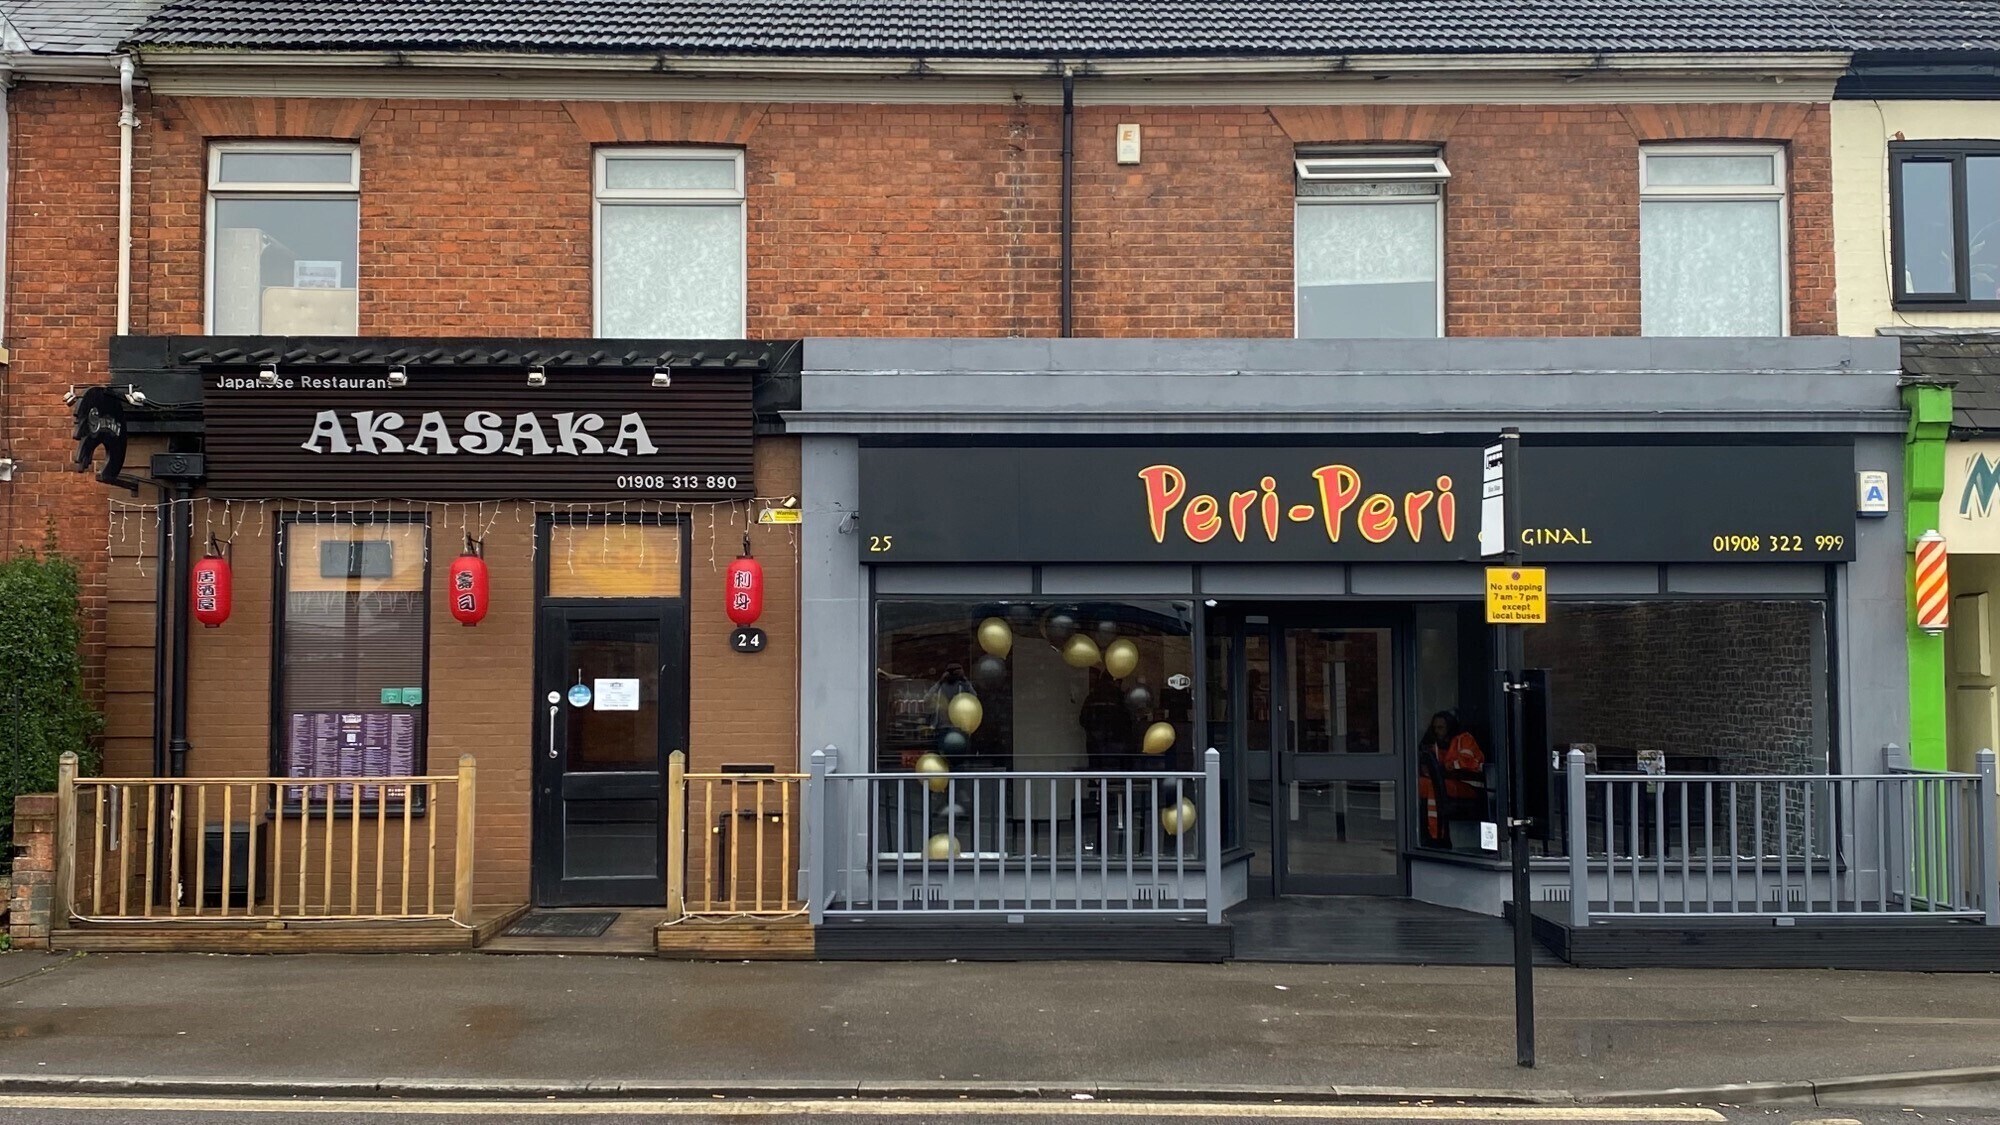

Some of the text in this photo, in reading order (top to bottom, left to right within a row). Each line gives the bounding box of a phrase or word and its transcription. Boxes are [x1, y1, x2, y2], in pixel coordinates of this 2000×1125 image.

[216, 375, 294, 390] Japanse
[301, 410, 659, 456] AKASAKA
[616, 475, 737, 489] 01908 313 890
[1138, 464, 1456, 543] Peri-Peri
[870, 535, 893, 552] 25
[1478, 527, 1592, 546] GINAL
[1713, 535, 1844, 552] 01908 322 999
[733, 570, 752, 610] 刺身
[1505, 583, 1543, 592] stopping
[1492, 611, 1541, 620] local buses
[738, 633, 760, 647] 24
